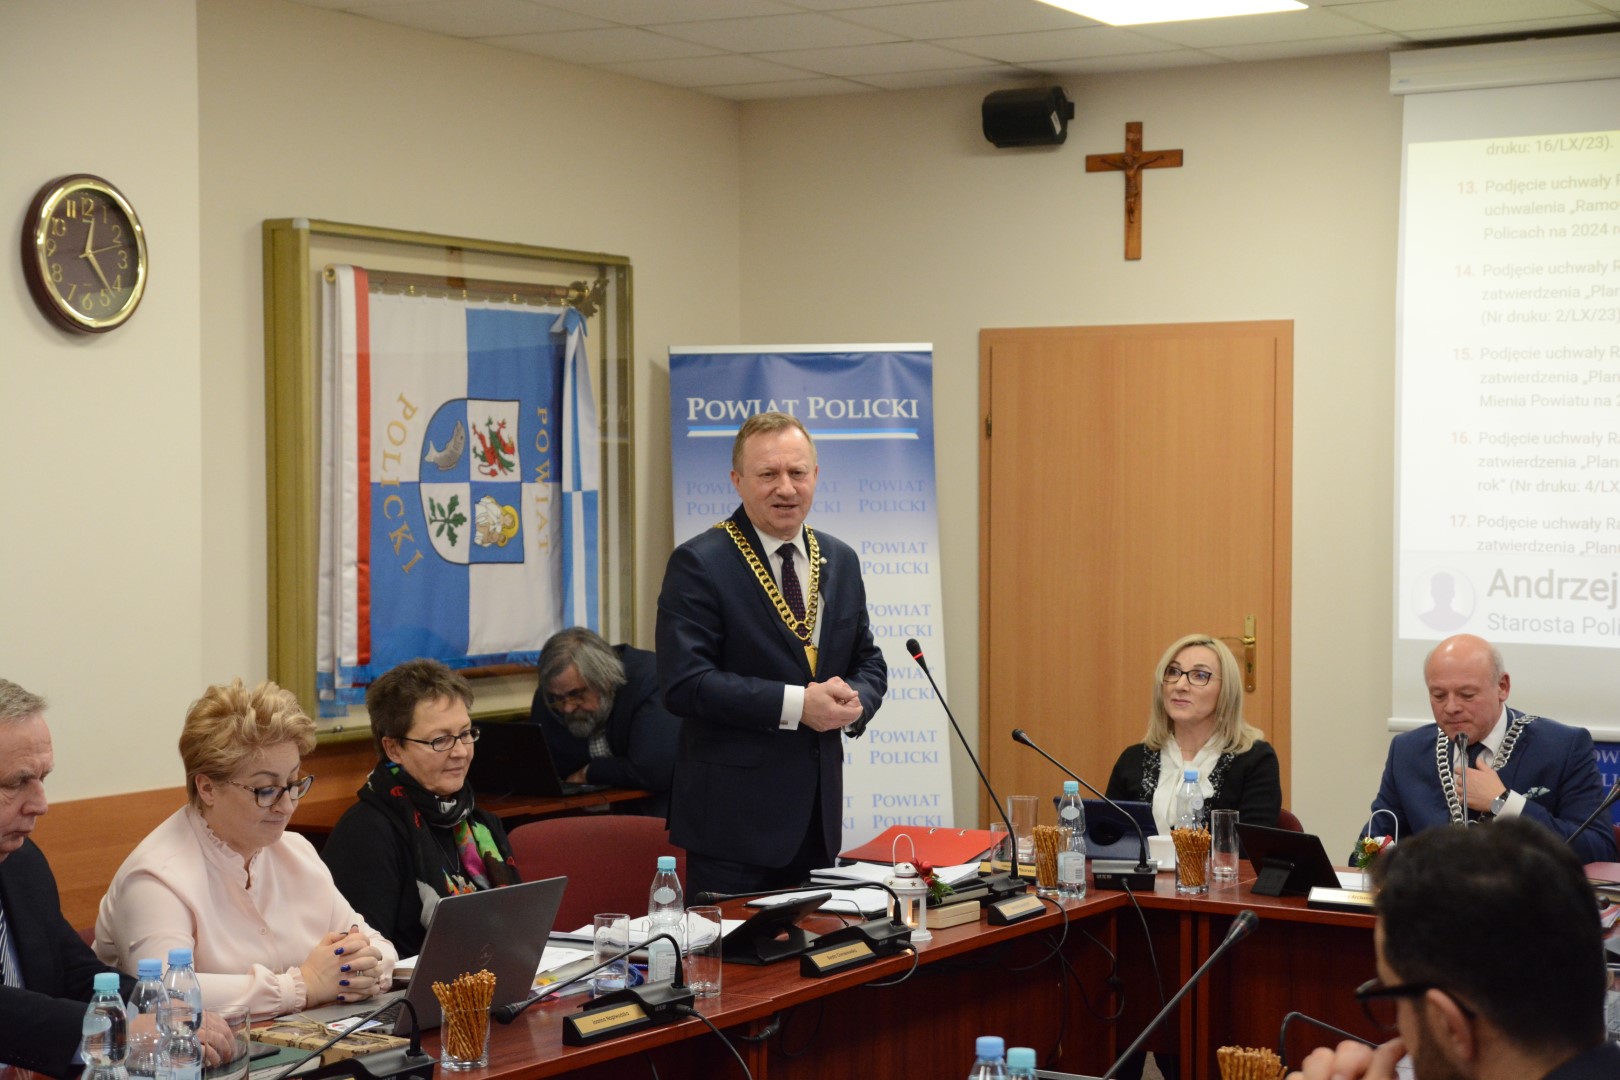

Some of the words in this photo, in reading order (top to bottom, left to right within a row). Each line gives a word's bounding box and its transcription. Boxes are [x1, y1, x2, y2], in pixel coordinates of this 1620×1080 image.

[1486, 141, 1530, 155] druku:
[1457, 181, 1477, 194] 13.
[1485, 179, 1546, 196] Podjęcie
[1551, 174, 1611, 191] uchwały
[66, 200, 76, 218] 11
[81, 197, 94, 217] 12
[1484, 200, 1565, 216] uchwalenia
[52, 217, 66, 236] 10
[112, 225, 122, 243] 2
[1484, 226, 1545, 240] Policach
[1549, 227, 1567, 238] na
[1571, 223, 1608, 237] 2024
[46, 239, 56, 257] 9
[117, 250, 128, 269] 3
[51, 263, 62, 282] 8
[1454, 264, 1475, 277] 14.
[1482, 263, 1544, 279] Podjęcie
[1548, 260, 1608, 276] uchwały
[112, 274, 121, 292] 4
[68, 283, 77, 301] 7
[99, 289, 110, 306] 5
[1481, 287, 1580, 301] zatwierdzenia
[82, 293, 93, 310] 6
[1481, 310, 1502, 326] (Nr
[1507, 309, 1552, 323] druku:
[1453, 348, 1473, 360] 15.
[1480, 346, 1541, 363] Podjęcie
[1545, 345, 1605, 362] uchwały
[1480, 371, 1578, 385] zatwierdzenia
[807, 396, 919, 419] POLICKI
[1480, 394, 1526, 407] Mienia
[1530, 394, 1589, 407] Powiatu
[1593, 395, 1611, 407] na
[1451, 432, 1471, 444] 16.
[1479, 432, 1539, 448] Podjęcie
[1543, 432, 1603, 448] uchwały
[1478, 456, 1576, 468] zatwierdzenia
[381, 392, 424, 575] POLICKI
[535, 407, 550, 554] POWIAT
[858, 479, 925, 492] POWIAT
[1510, 479, 1532, 494] (Nr
[1536, 479, 1580, 493] druku:
[858, 499, 926, 512] POLICKI
[1450, 515, 1470, 528] 17.
[1477, 514, 1538, 531] Podjęcie
[1542, 516, 1601, 532] uchwały
[861, 541, 928, 554] POWIAT
[1477, 539, 1576, 554] zatwierdzenia
[862, 561, 929, 574] POLICKI
[1487, 568, 1618, 609] Andrzej
[1487, 613, 1575, 634] Starosta
[870, 730, 937, 744] POWIAT
[870, 751, 938, 764] POLICKI
[872, 794, 940, 808] POWIAT
